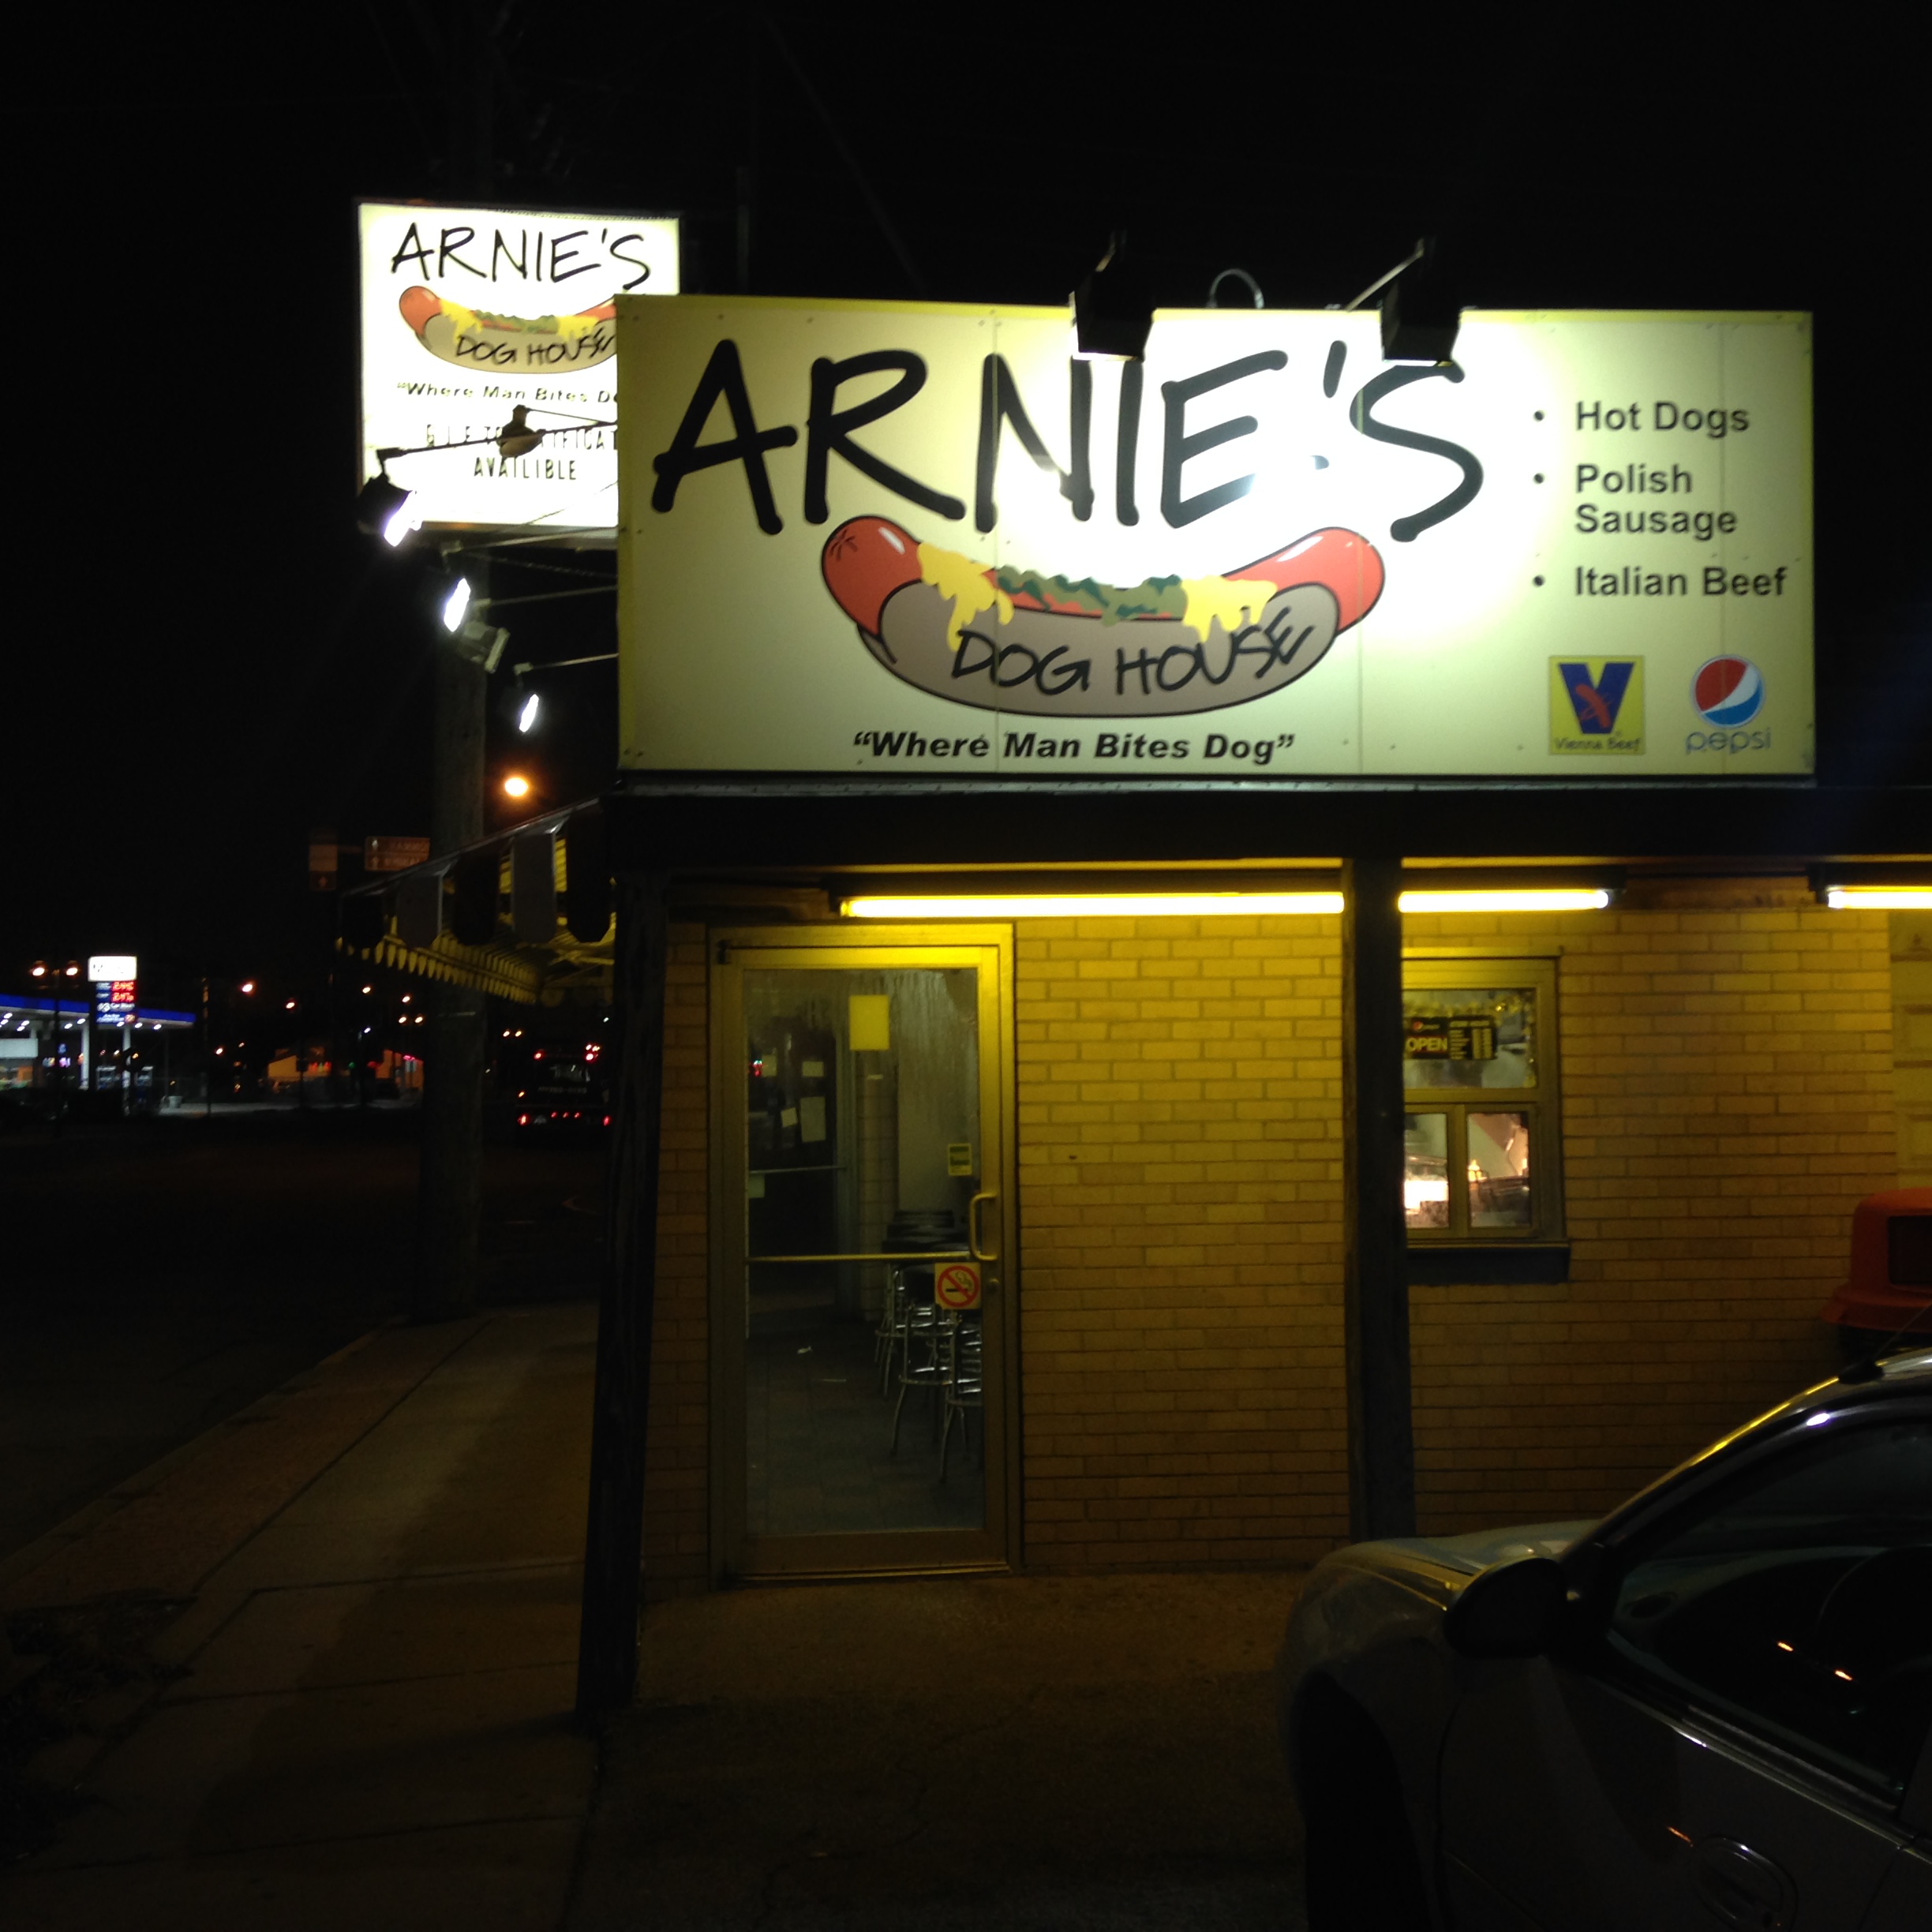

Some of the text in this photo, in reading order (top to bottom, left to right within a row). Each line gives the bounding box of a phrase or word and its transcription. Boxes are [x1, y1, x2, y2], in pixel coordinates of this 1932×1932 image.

[391, 223, 651, 290] ARNIE'S
[456, 327, 616, 365] DOG HOUSE
[483, 386, 526, 399] Man
[535, 388, 587, 402] Bites
[1575, 401, 1750, 439] Hot Dogs
[652, 339, 1484, 542] ARNIE'S
[474, 456, 577, 481] AVAILIBLE
[1576, 463, 1693, 493] Polish
[1575, 504, 1738, 541] Sausage
[1576, 566, 1788, 596] Italian Beef
[953, 606, 1316, 695] DOG HOUSE
[1004, 733, 1080, 758] Man
[1095, 732, 1190, 758] Bites
[1686, 728, 1771, 755] pepsi
[1406, 1037, 1447, 1052] OPEN
